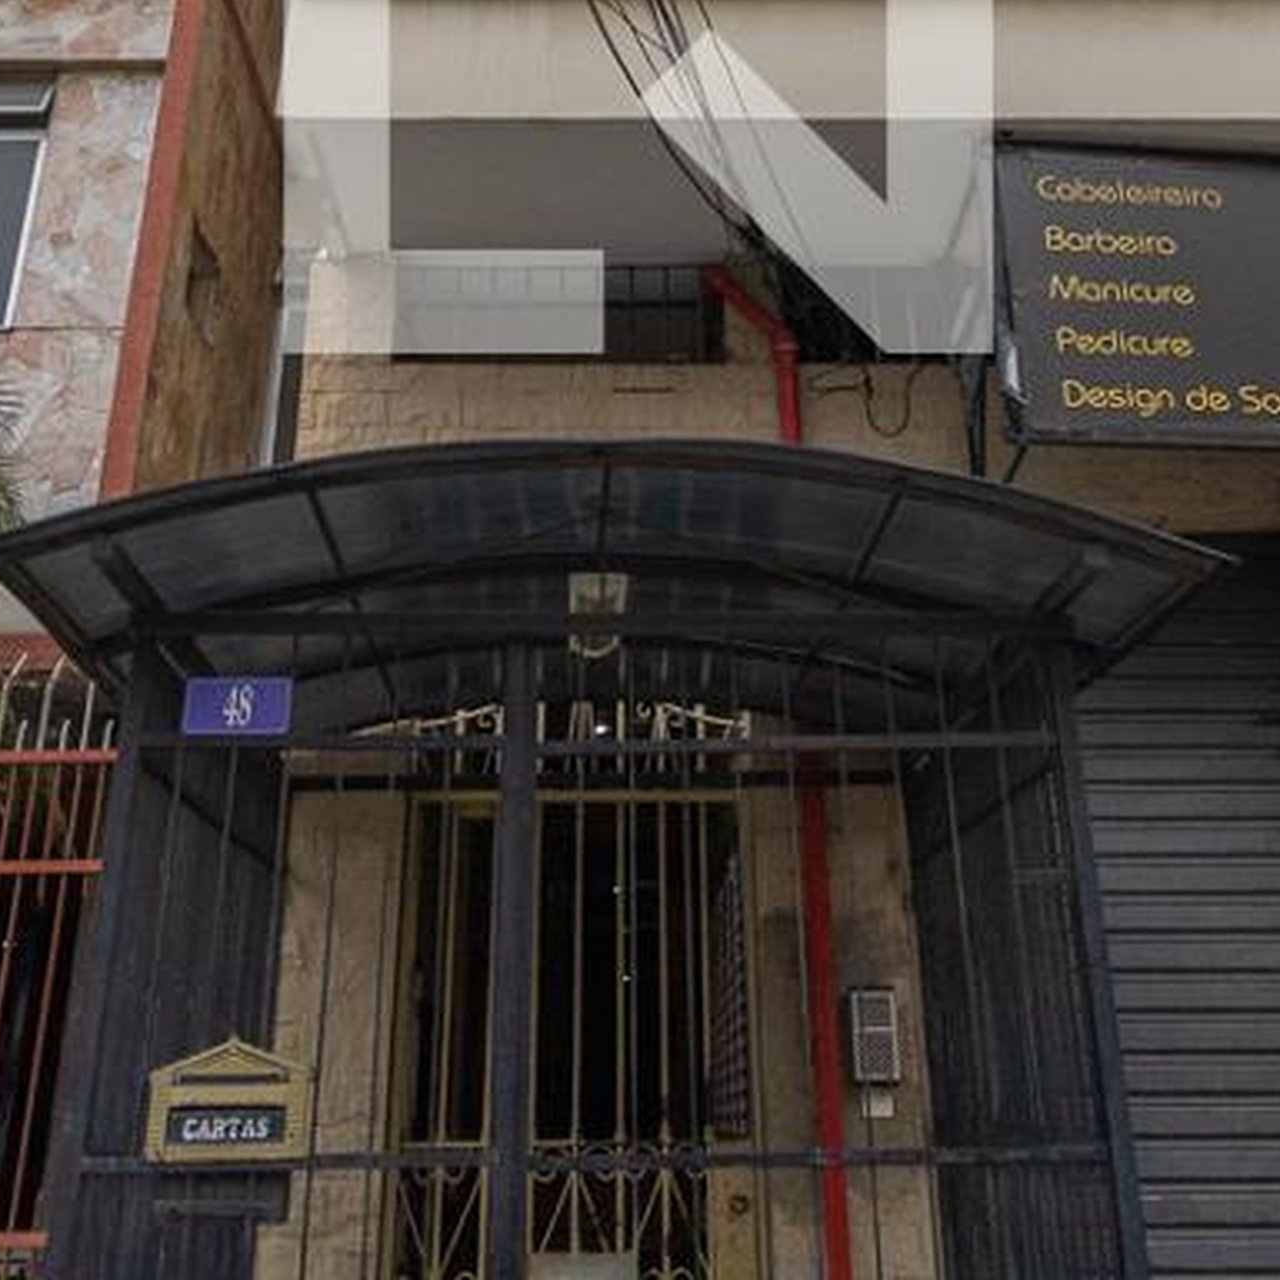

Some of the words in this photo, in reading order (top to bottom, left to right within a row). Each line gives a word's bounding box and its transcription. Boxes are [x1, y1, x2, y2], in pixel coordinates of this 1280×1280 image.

[1036, 175, 1224, 209] Cabeleireiro
[1043, 224, 1178, 257] Barbeiro
[1048, 273, 1197, 306] Manicure
[1055, 324, 1196, 359] Pedicure
[1061, 378, 1176, 418] Design
[1185, 384, 1231, 413] de
[222, 683, 255, 728] 48
[181, 1116, 271, 1142] CARTAS
